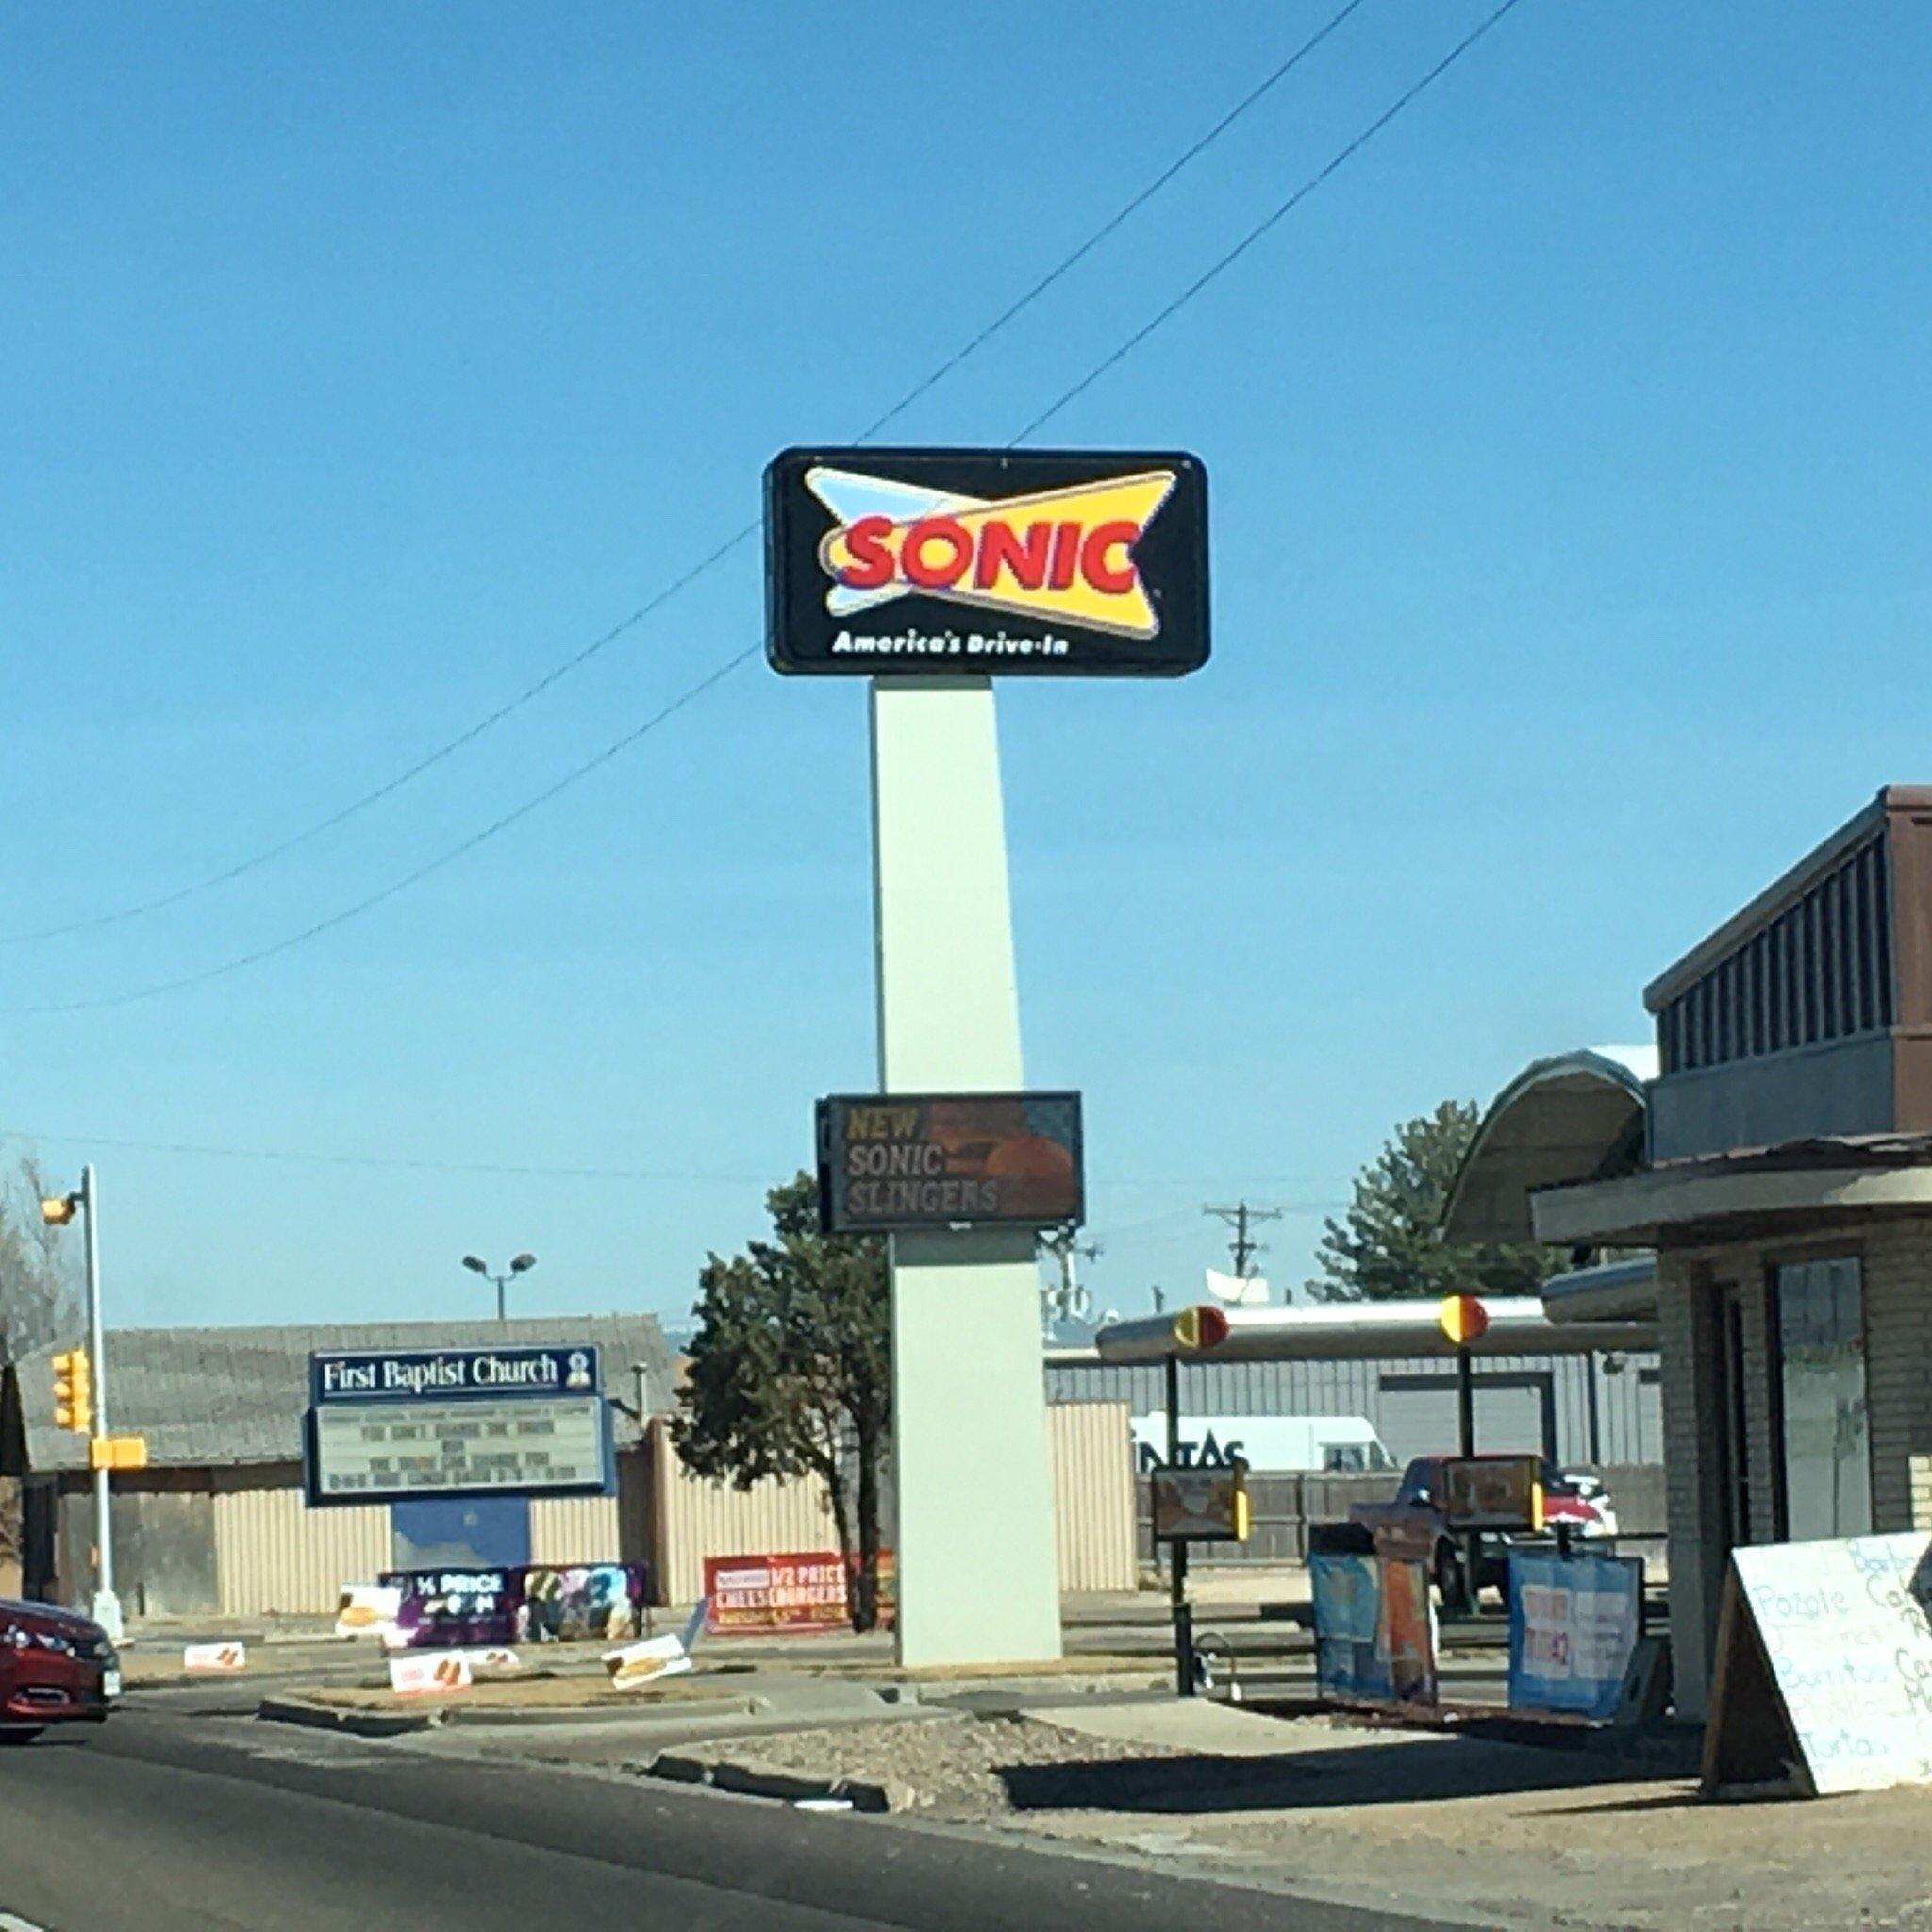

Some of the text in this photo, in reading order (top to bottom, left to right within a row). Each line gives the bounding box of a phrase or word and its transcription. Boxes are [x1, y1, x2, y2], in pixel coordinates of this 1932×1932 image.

[836, 514, 1140, 594] SONIC
[832, 628, 1069, 655] America's Drive-In
[849, 1107, 918, 1140] NEW
[848, 1144, 942, 1176] SONIC
[848, 1179, 998, 1214] SLINGERS
[324, 1353, 558, 1394] First Baptist Church
